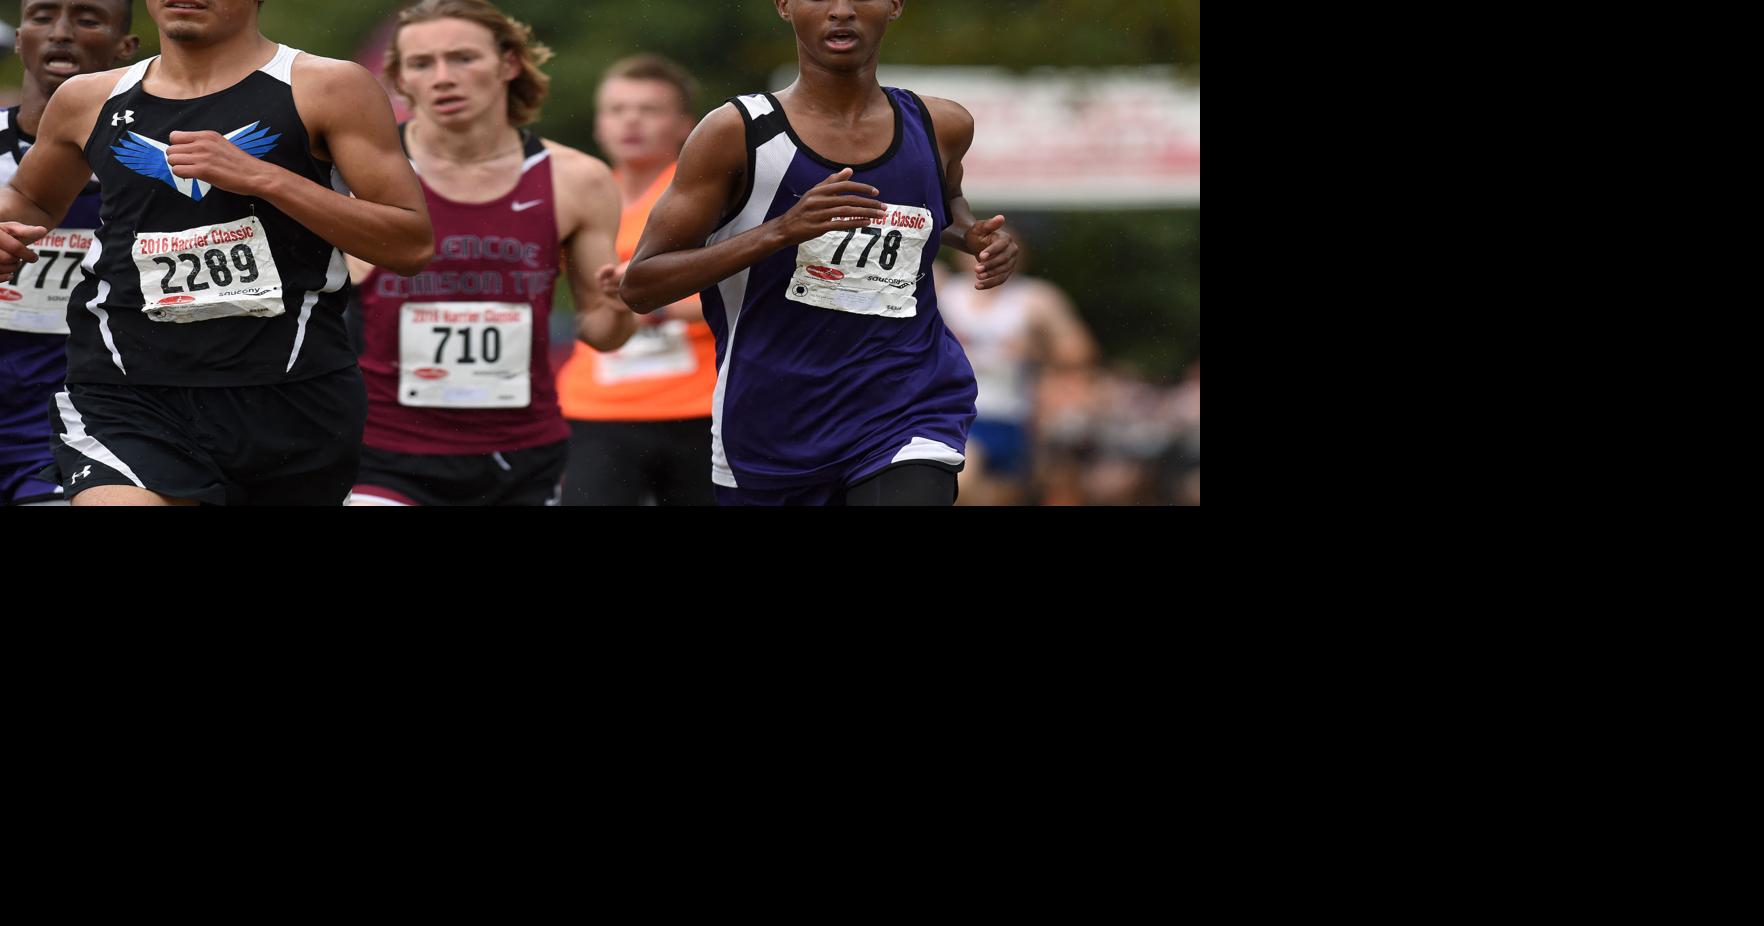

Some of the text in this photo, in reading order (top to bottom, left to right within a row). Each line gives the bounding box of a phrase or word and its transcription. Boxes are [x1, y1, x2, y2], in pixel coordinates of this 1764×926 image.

[891, 210, 926, 230] Classic
[140, 225, 254, 255] 2016 Harrier Classic
[831, 226, 903, 271] 778
[152, 243, 259, 294] 2289
[218, 287, 261, 297] saucony
[432, 326, 501, 364] 710
